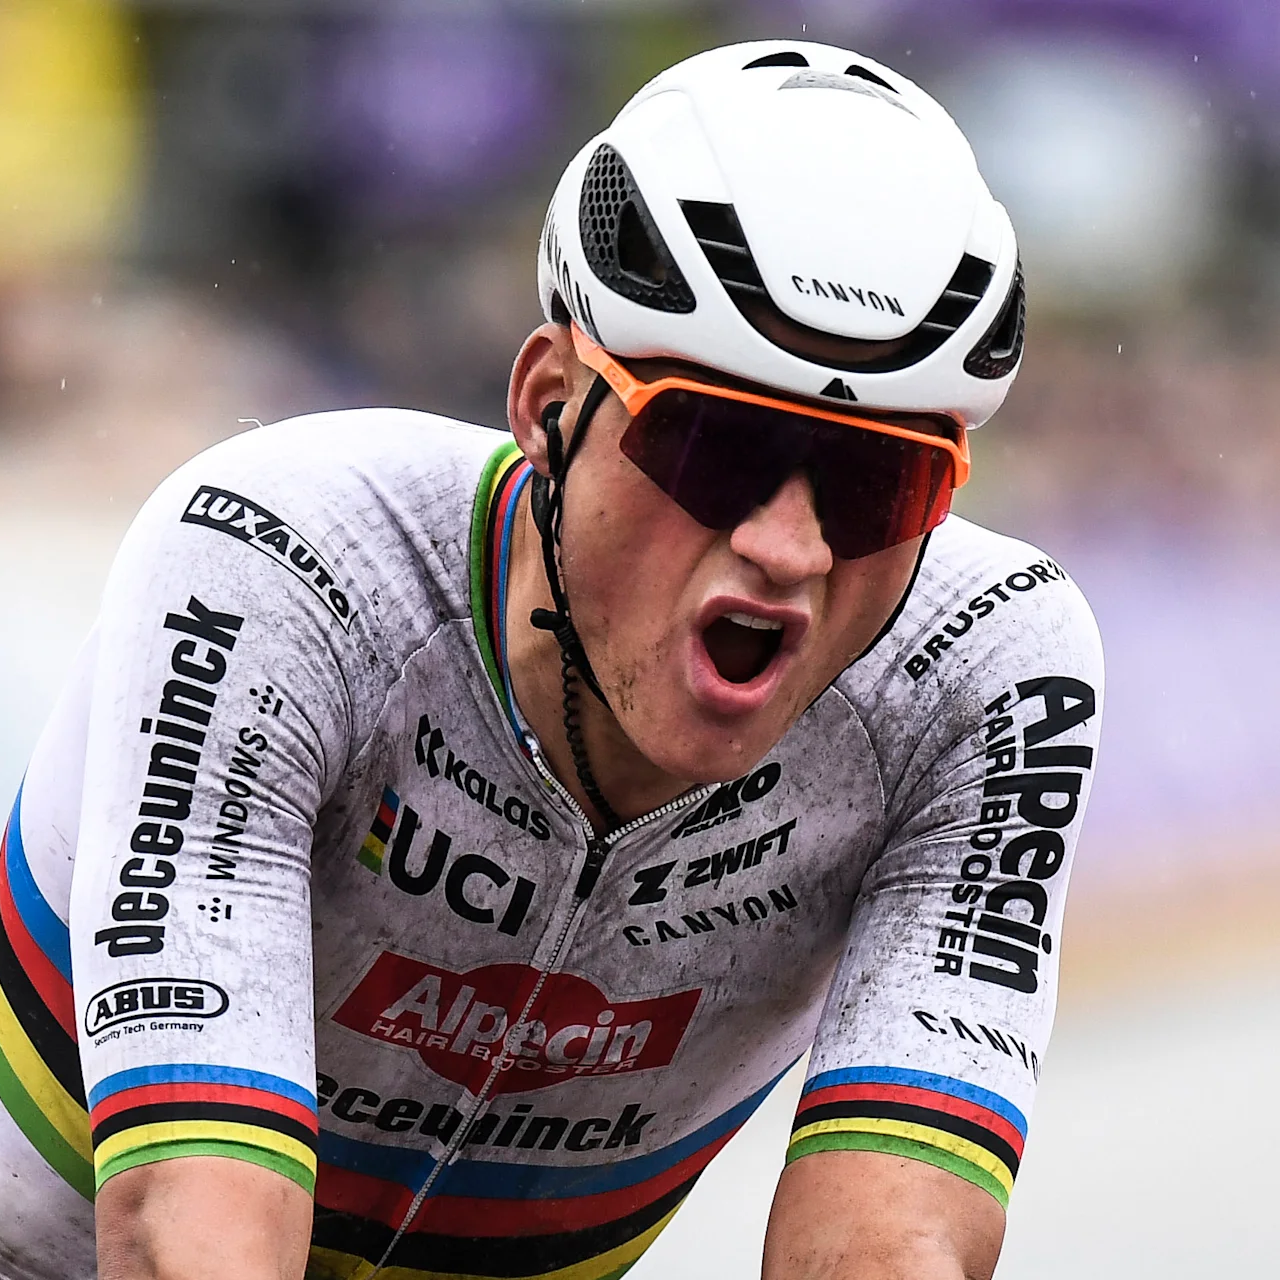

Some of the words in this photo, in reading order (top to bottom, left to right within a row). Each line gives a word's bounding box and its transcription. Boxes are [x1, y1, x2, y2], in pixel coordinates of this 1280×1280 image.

[791, 275, 905, 317] CANYON
[903, 562, 1058, 682] BRUSTOR
[94, 594, 246, 959] deceuninck
[984, 691, 1017, 777] HAIR
[205, 726, 269, 880] WINDOWS
[969, 675, 1096, 994] Alpecin
[387, 803, 537, 938] UCI
[683, 816, 798, 890] ZWIFT
[934, 799, 1012, 977] BOOSTER
[622, 883, 799, 947] CANYON
[93, 985, 205, 1028] ABUS
[123, 1022, 146, 1035] Tech
[149, 1021, 205, 1033] Germany
[369, 1019, 451, 1052] HAIR
[470, 1043, 639, 1075] BOOSTER
[379, 973, 654, 1066] Alpecin
[911, 1010, 1042, 1087] CANYO
[316, 1069, 658, 1153] eceuninck
